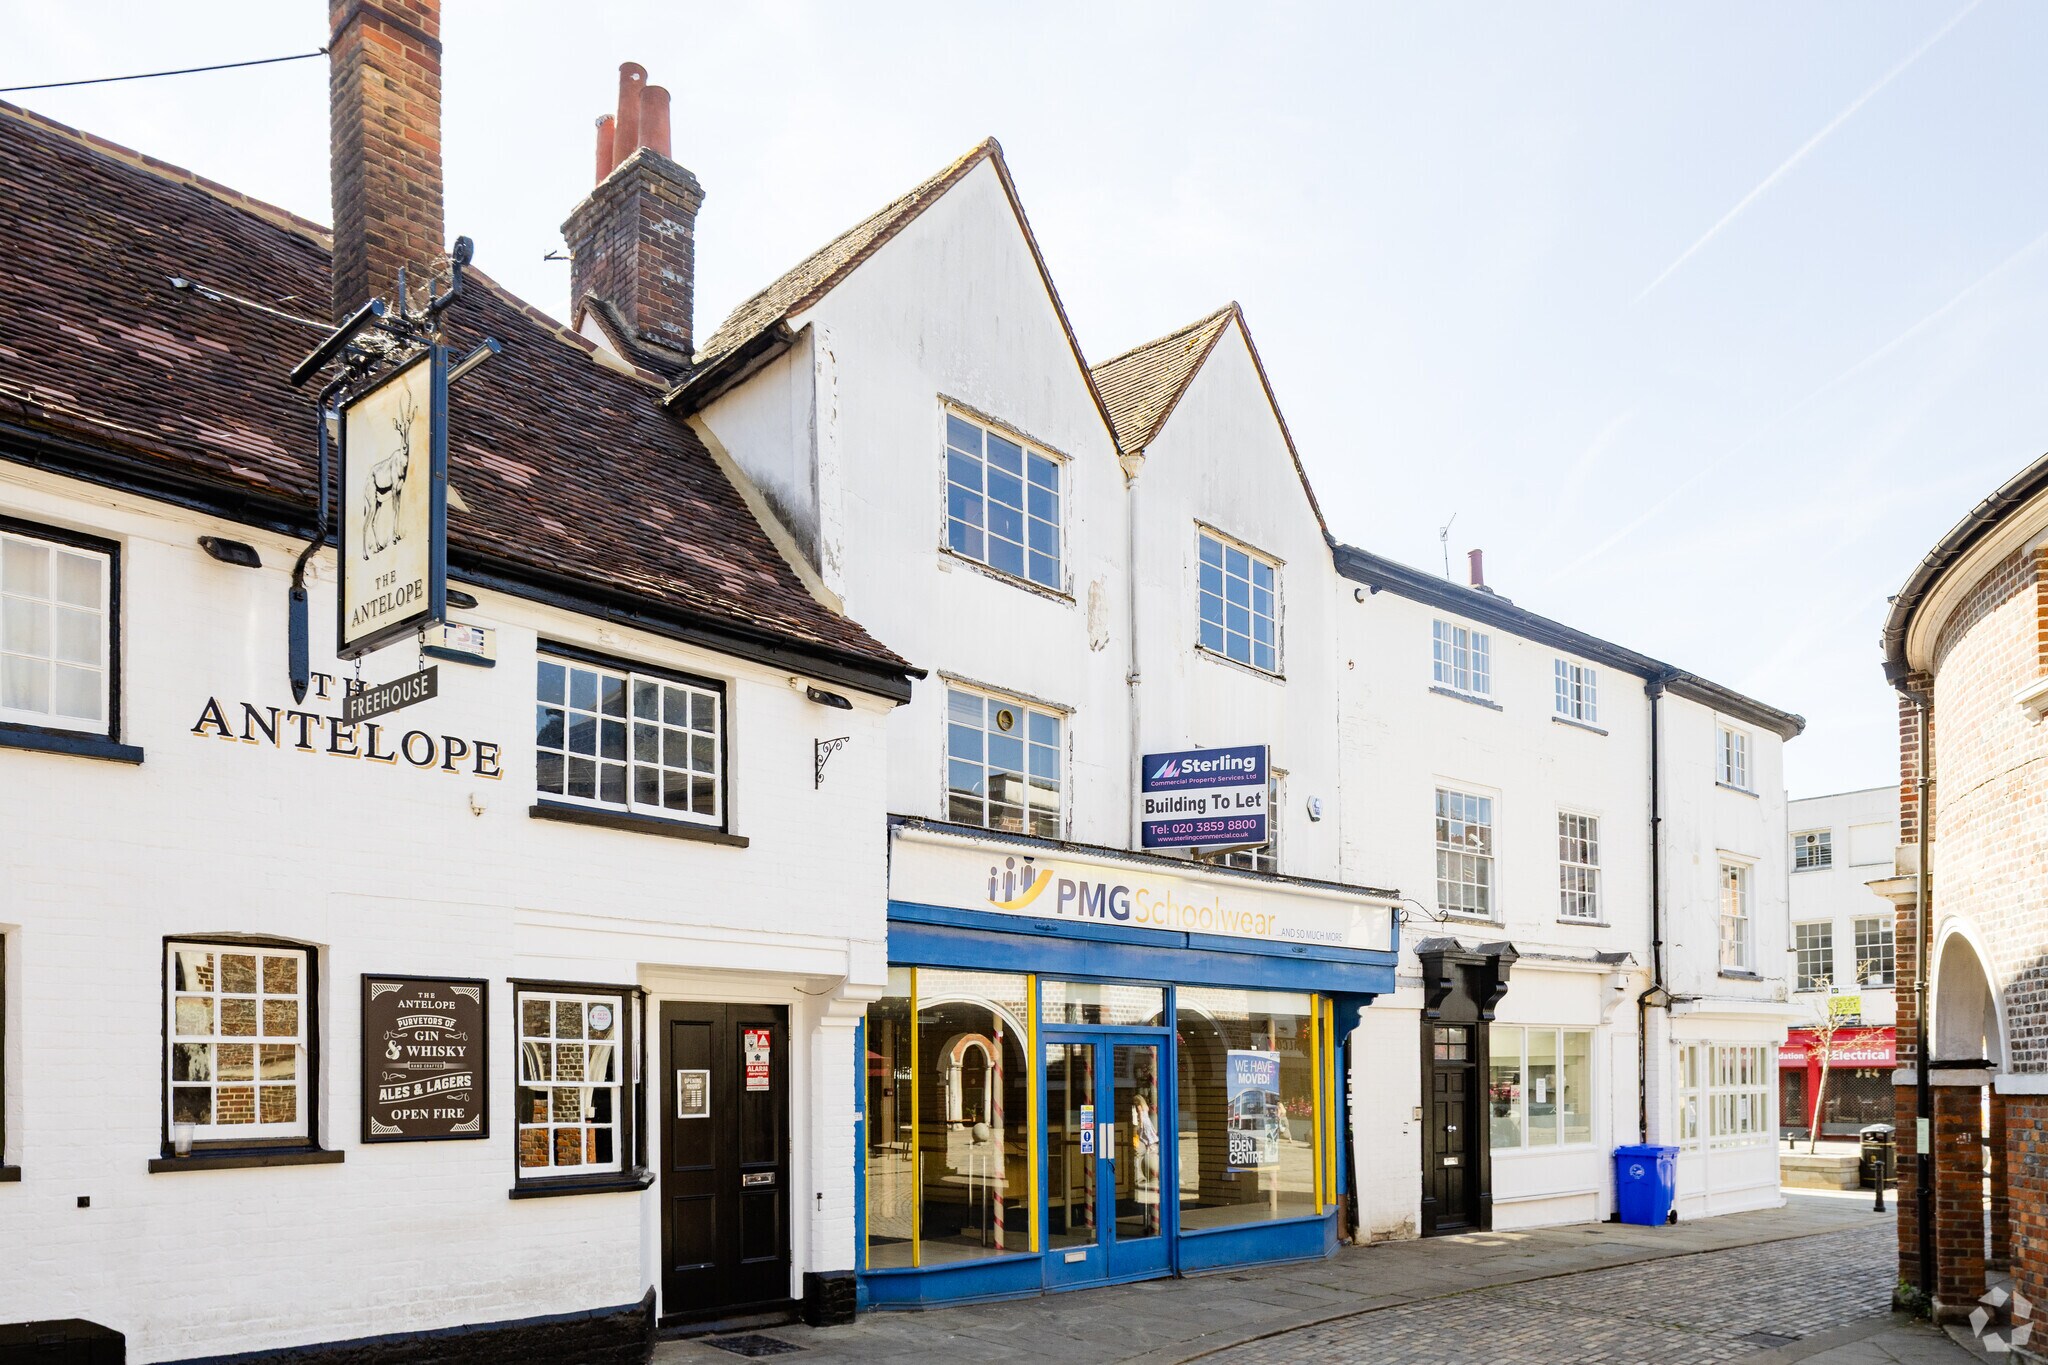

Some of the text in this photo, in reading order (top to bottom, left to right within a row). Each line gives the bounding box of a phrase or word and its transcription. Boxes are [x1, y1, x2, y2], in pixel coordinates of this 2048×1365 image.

[375, 570, 397, 590] THE
[352, 579, 424, 627] ANTELOPE
[351, 675, 429, 719] FREEHOUSE
[190, 696, 504, 779] ANTELOPE
[1181, 754, 1256, 774] Sterling
[1150, 778, 1188, 787] Commercial
[1189, 776, 1217, 785] Property
[1217, 774, 1245, 782] Services
[1145, 791, 1262, 815] Building To Let
[1150, 819, 1257, 835] Tel: 020 3859 8800
[1157, 831, 1249, 843] www.sterlingcommercial.co.uk
[1057, 878, 1131, 921] PMG
[1135, 887, 1276, 936] Schoolwear
[1296, 929, 1306, 939] SO
[1306, 930, 1325, 941] MUCH
[1325, 932, 1343, 942] MORE
[397, 1000, 456, 1010] ANTELOPE
[398, 1017, 443, 1028] PURVEYORS
[414, 1031, 440, 1041] GIN
[385, 1040, 467, 1060] & WHISKY
[1831, 1049, 1890, 1061] Electrical
[1235, 1059, 1273, 1073] WE HAVE
[1238, 1072, 1270, 1085] MOVED!
[379, 1075, 472, 1101] ALES & LAGERS
[390, 1108, 466, 1120] OPEN FIRE
[1229, 1139, 1253, 1152] EDEN
[1229, 1151, 1264, 1165] CENTRE
